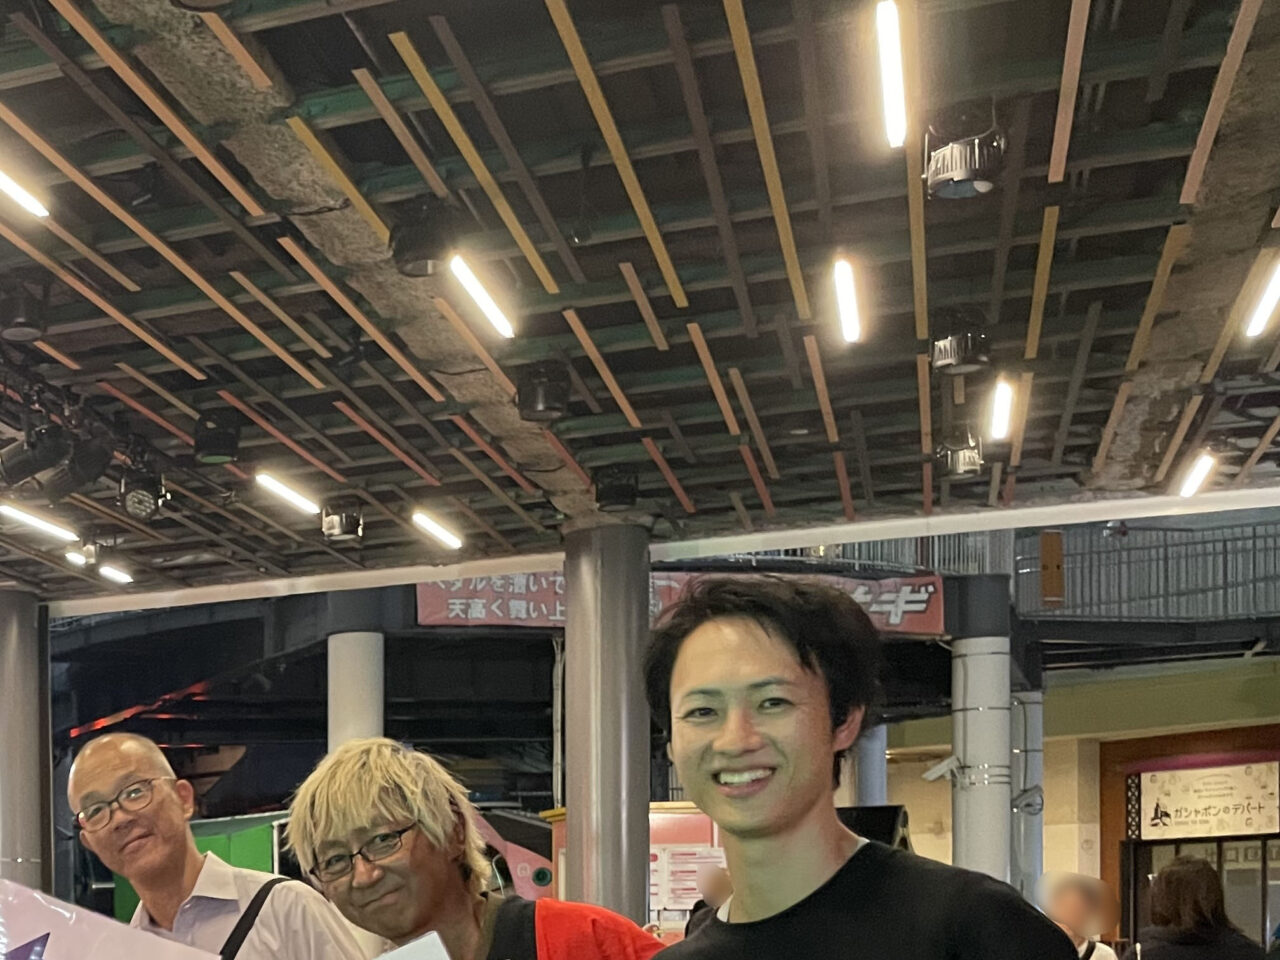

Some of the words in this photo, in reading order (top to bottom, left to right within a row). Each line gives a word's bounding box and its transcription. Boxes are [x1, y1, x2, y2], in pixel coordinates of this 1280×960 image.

[1174, 802, 1265, 819] ガシャポンのデパート
